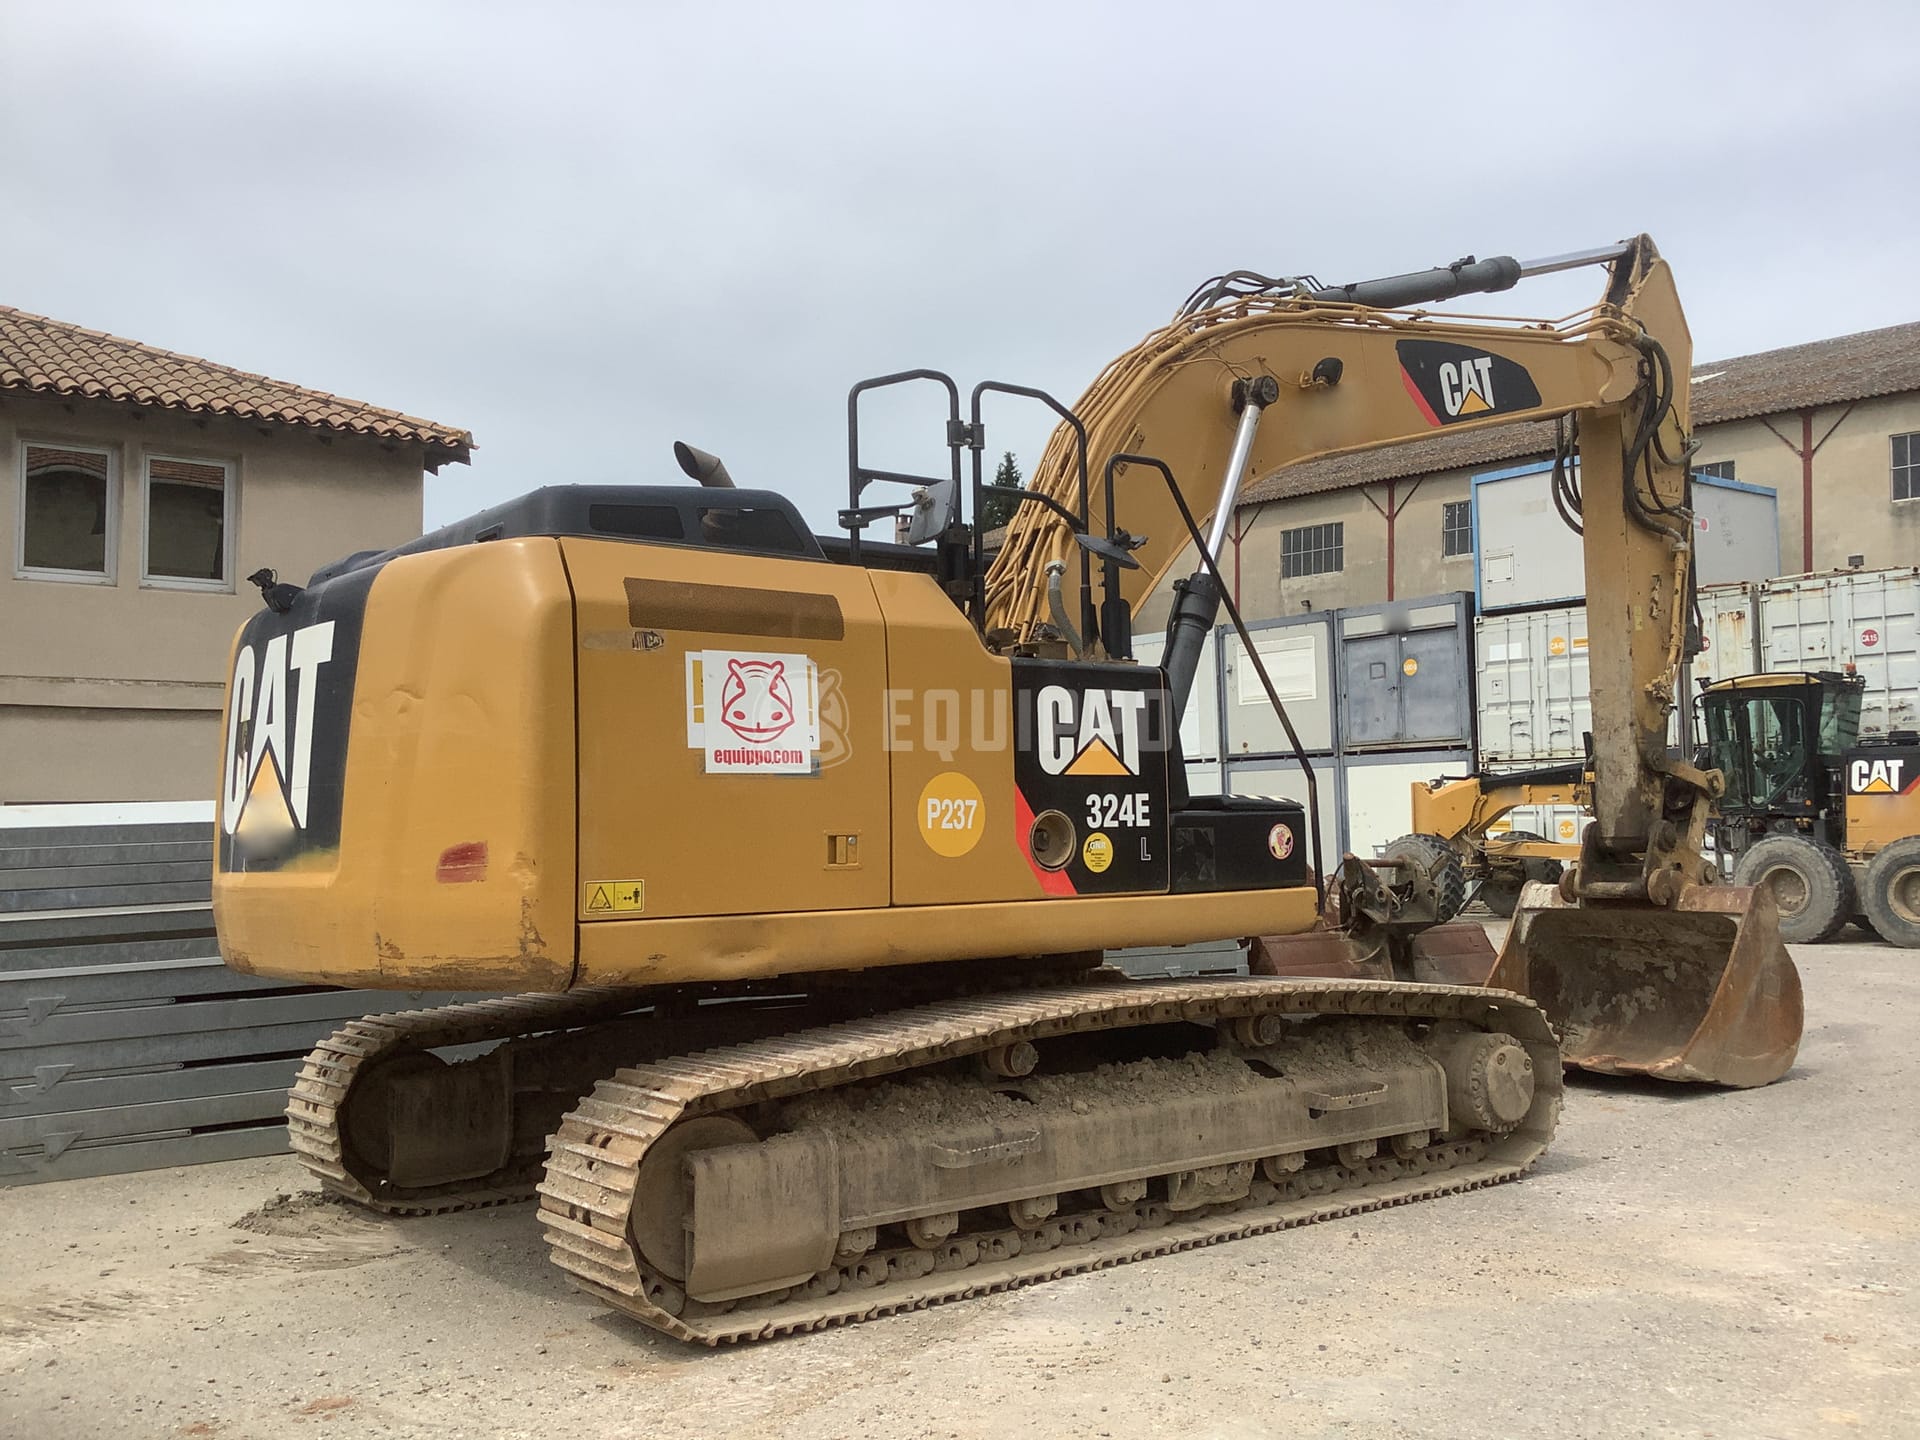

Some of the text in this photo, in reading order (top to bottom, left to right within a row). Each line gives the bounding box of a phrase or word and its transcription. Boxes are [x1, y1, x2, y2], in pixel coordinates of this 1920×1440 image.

[1438, 356, 1495, 416] CAT
[224, 620, 335, 834] CAT
[1037, 685, 1146, 776] CAT
[714, 747, 803, 765] equippo.com
[1851, 760, 1904, 792] CAT
[927, 798, 978, 831] P237
[1086, 793, 1150, 829] 324E
[1141, 837, 1151, 860] L
